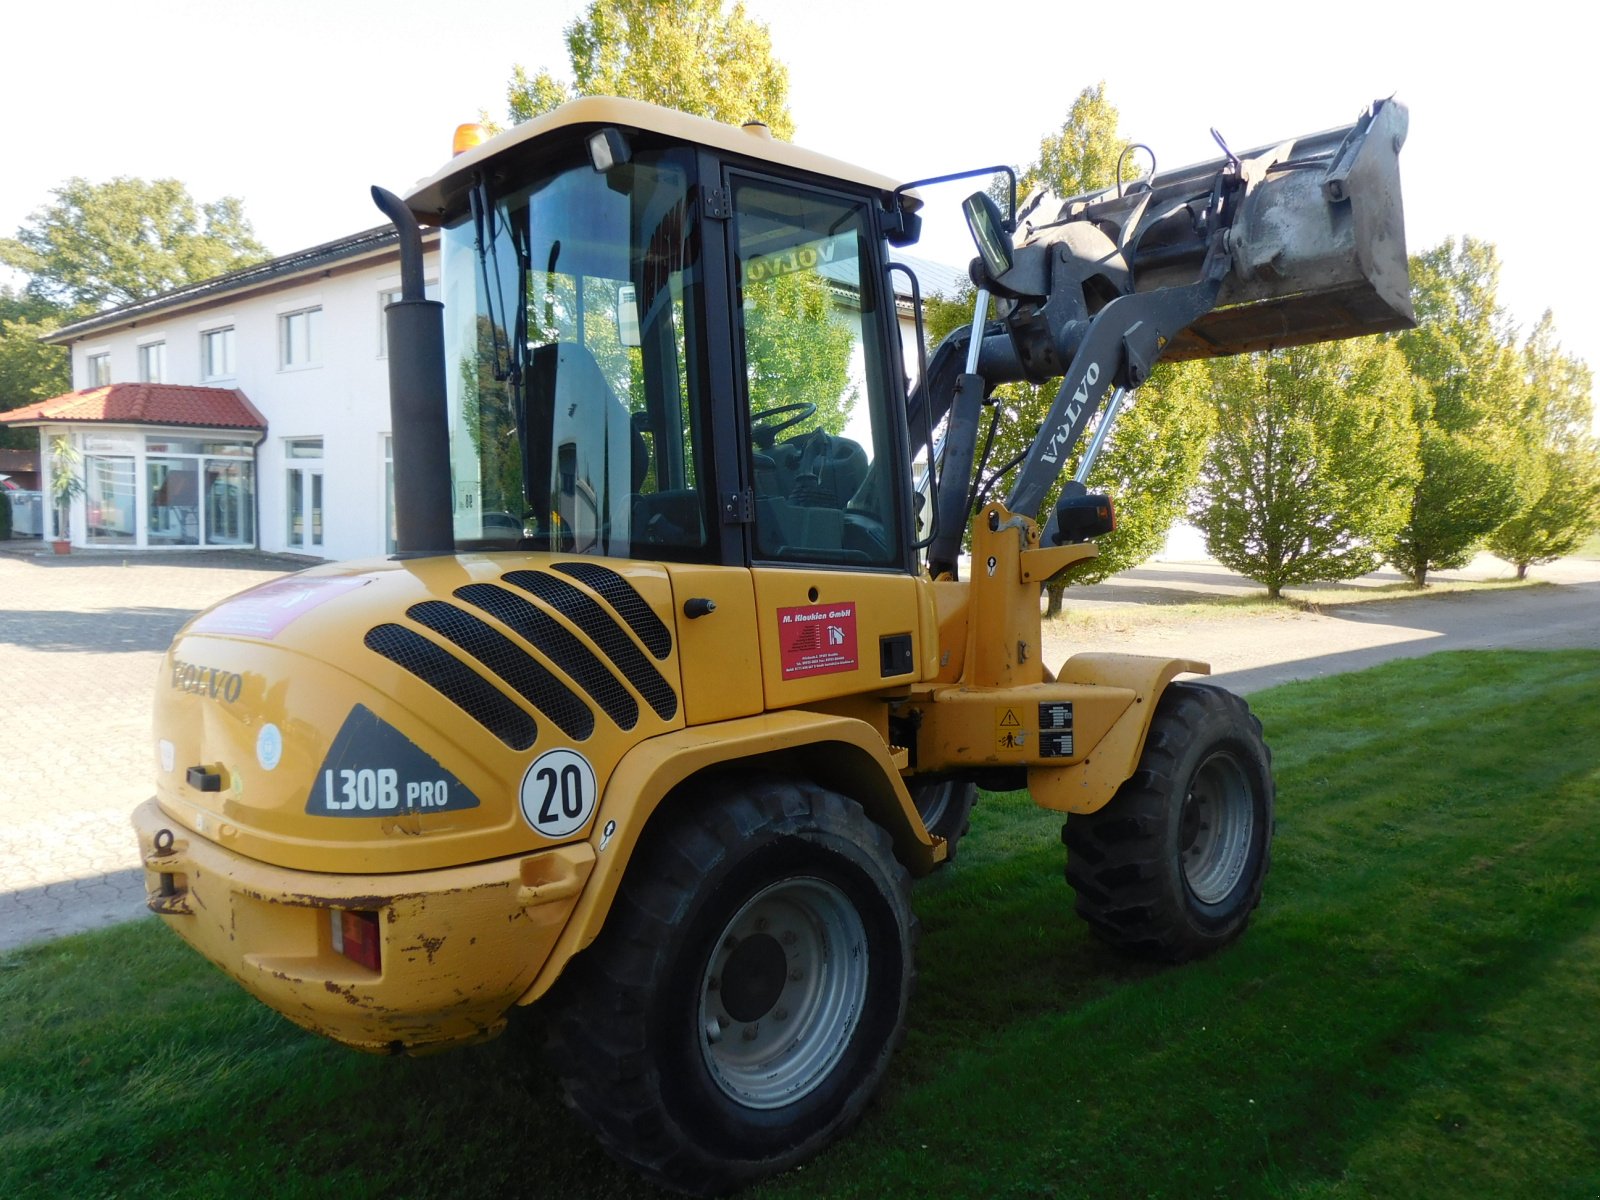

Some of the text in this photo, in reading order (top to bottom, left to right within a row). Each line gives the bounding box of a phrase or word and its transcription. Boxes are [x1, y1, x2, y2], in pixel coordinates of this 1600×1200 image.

[1040, 362, 1100, 464] VOLVO
[782, 615, 793, 623] M.
[828, 609, 851, 619] GmbH
[172, 660, 243, 704] VOLVO
[325, 768, 448, 810] L30B PRO
[536, 763, 583, 824] 20
